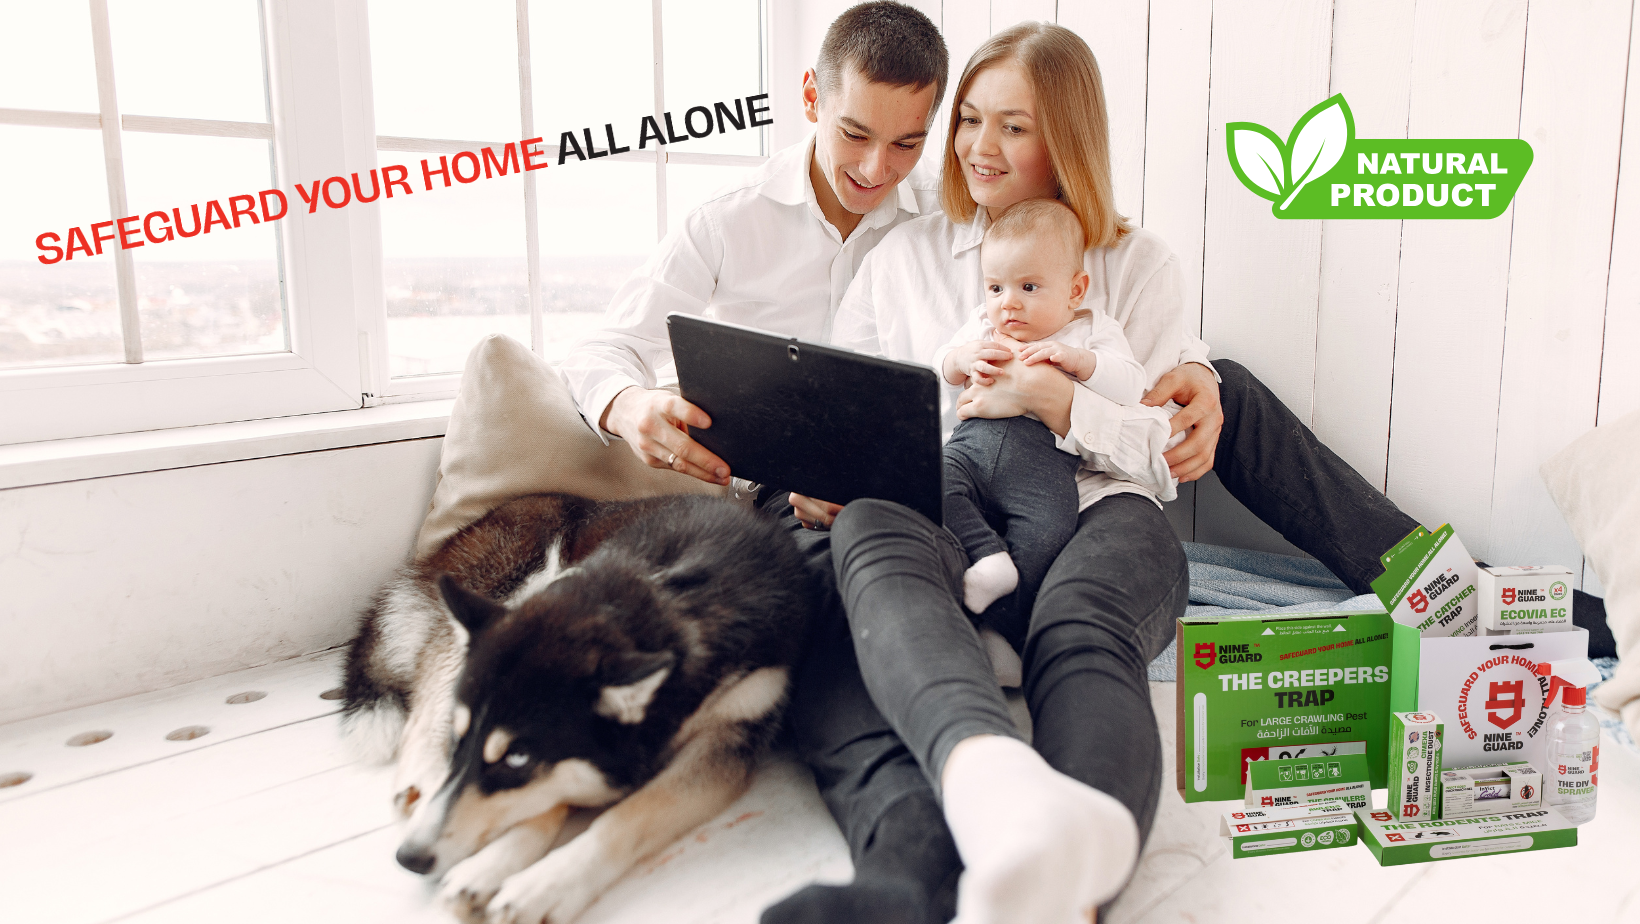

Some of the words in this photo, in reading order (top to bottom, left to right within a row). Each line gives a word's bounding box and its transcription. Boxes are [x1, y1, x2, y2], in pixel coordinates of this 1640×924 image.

[1424, 573, 1447, 594] NINE
[1429, 574, 1460, 600] GUARD
[1416, 616, 1436, 632] THE
[1434, 584, 1476, 619] CATCHER
[1500, 609, 1547, 620] ECOVIA
[1550, 608, 1566, 618] EC
[1438, 606, 1462, 628] TRAP
[1219, 644, 1250, 654] NINE
[1279, 648, 1317, 660] SAFEGUARD
[1318, 643, 1335, 653] YOUR
[1336, 640, 1354, 649] HOME
[1354, 637, 1366, 645] ALL
[1366, 633, 1389, 644] ALONE!
[1219, 653, 1262, 664] GUARD
[1218, 672, 1263, 692] THE
[1267, 665, 1389, 689] CREEPERS
[1274, 690, 1335, 708] TRAP
[1458, 672, 1479, 740] SAFEGUARD
[1477, 655, 1509, 673] YOUR
[1241, 719, 1258, 727] For
[1260, 716, 1292, 726] LARGE
[1294, 714, 1344, 724] CRAWLING
[1346, 712, 1367, 721] Pest
[1257, 729, 1289, 739] الزاحفة
[1292, 726, 1318, 736] الآفات
[1321, 725, 1352, 736] مصيدة
[1483, 733, 1512, 742] NINE
[1483, 741, 1523, 752] GUARD
[1425, 750, 1433, 793] INSECTICIDE
[1558, 786, 1594, 795] SPRAYER
[1418, 816, 1502, 828] RODENTS
[1502, 810, 1549, 820] TRAP
